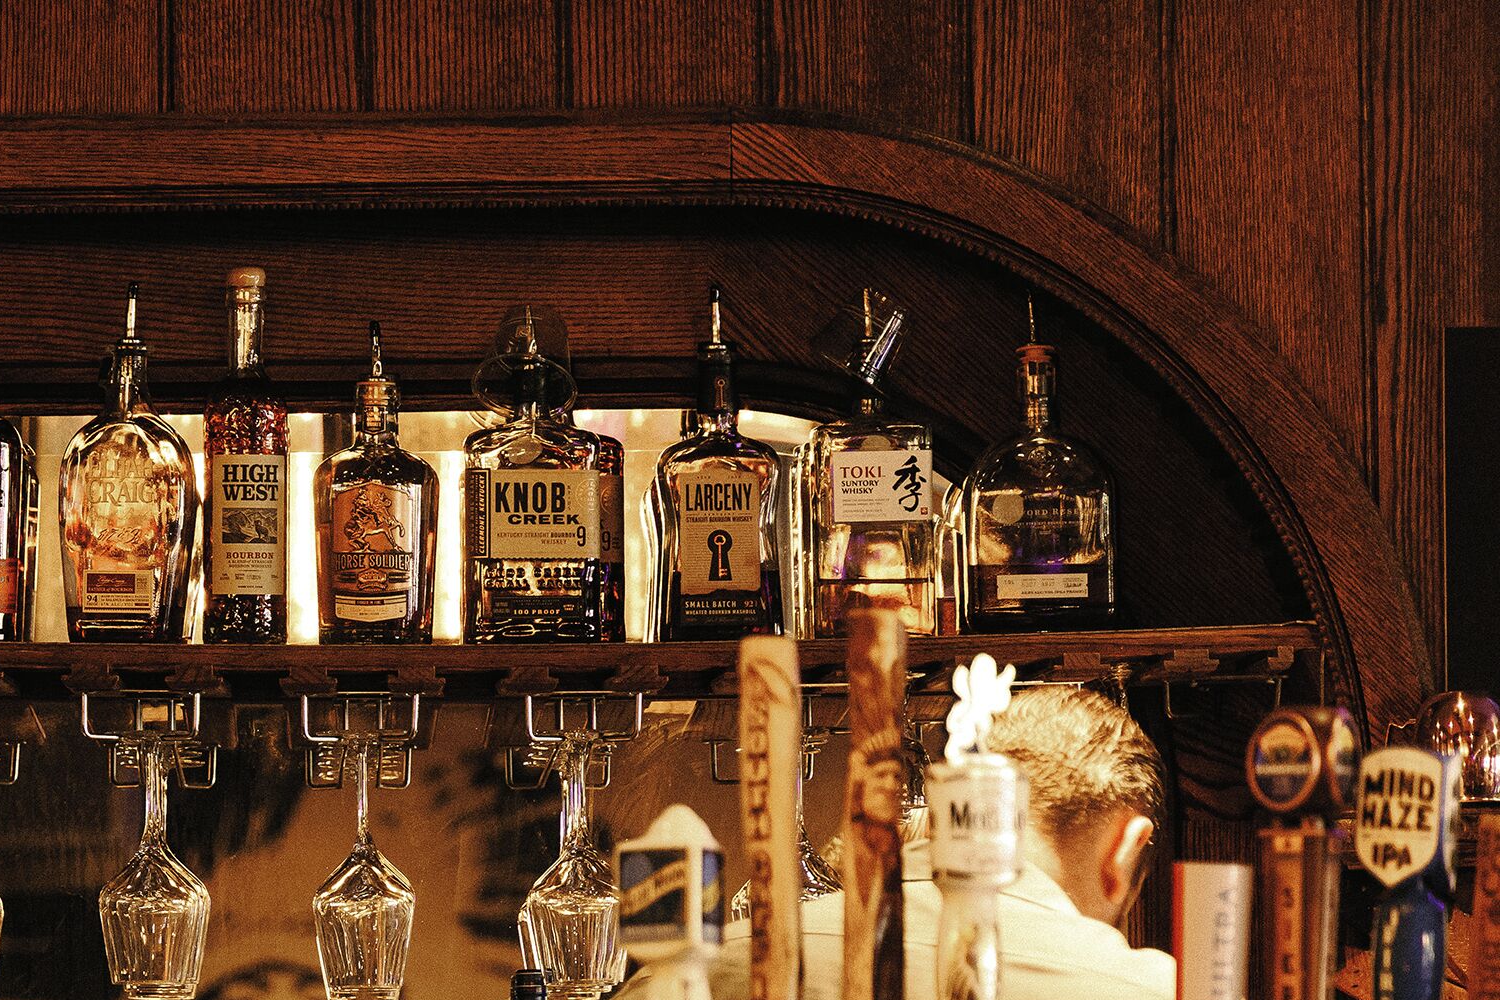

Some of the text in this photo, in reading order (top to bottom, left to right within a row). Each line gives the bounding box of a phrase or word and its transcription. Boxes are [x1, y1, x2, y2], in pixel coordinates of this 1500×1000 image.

[222, 464, 279, 483] HIGH
[840, 466, 883, 479] TOKI
[892, 455, 927, 513] 季
[87, 479, 156, 506] CRAIG
[222, 484, 279, 501] WEST
[478, 475, 486, 513] KENTUCKY
[495, 482, 566, 513] KNOB
[685, 483, 752, 511] LARCENY
[841, 487, 874, 495] WHISKY
[507, 514, 580, 525] CREEK
[576, 526, 611, 551] 9 9
[336, 554, 411, 570] HORSE SOLDIER
[86, 594, 98, 602] 94
[685, 601, 710, 609] SMALL
[1365, 768, 1435, 802] MIND
[1362, 801, 1435, 832] HAZE
[1372, 843, 1412, 869] IPA
